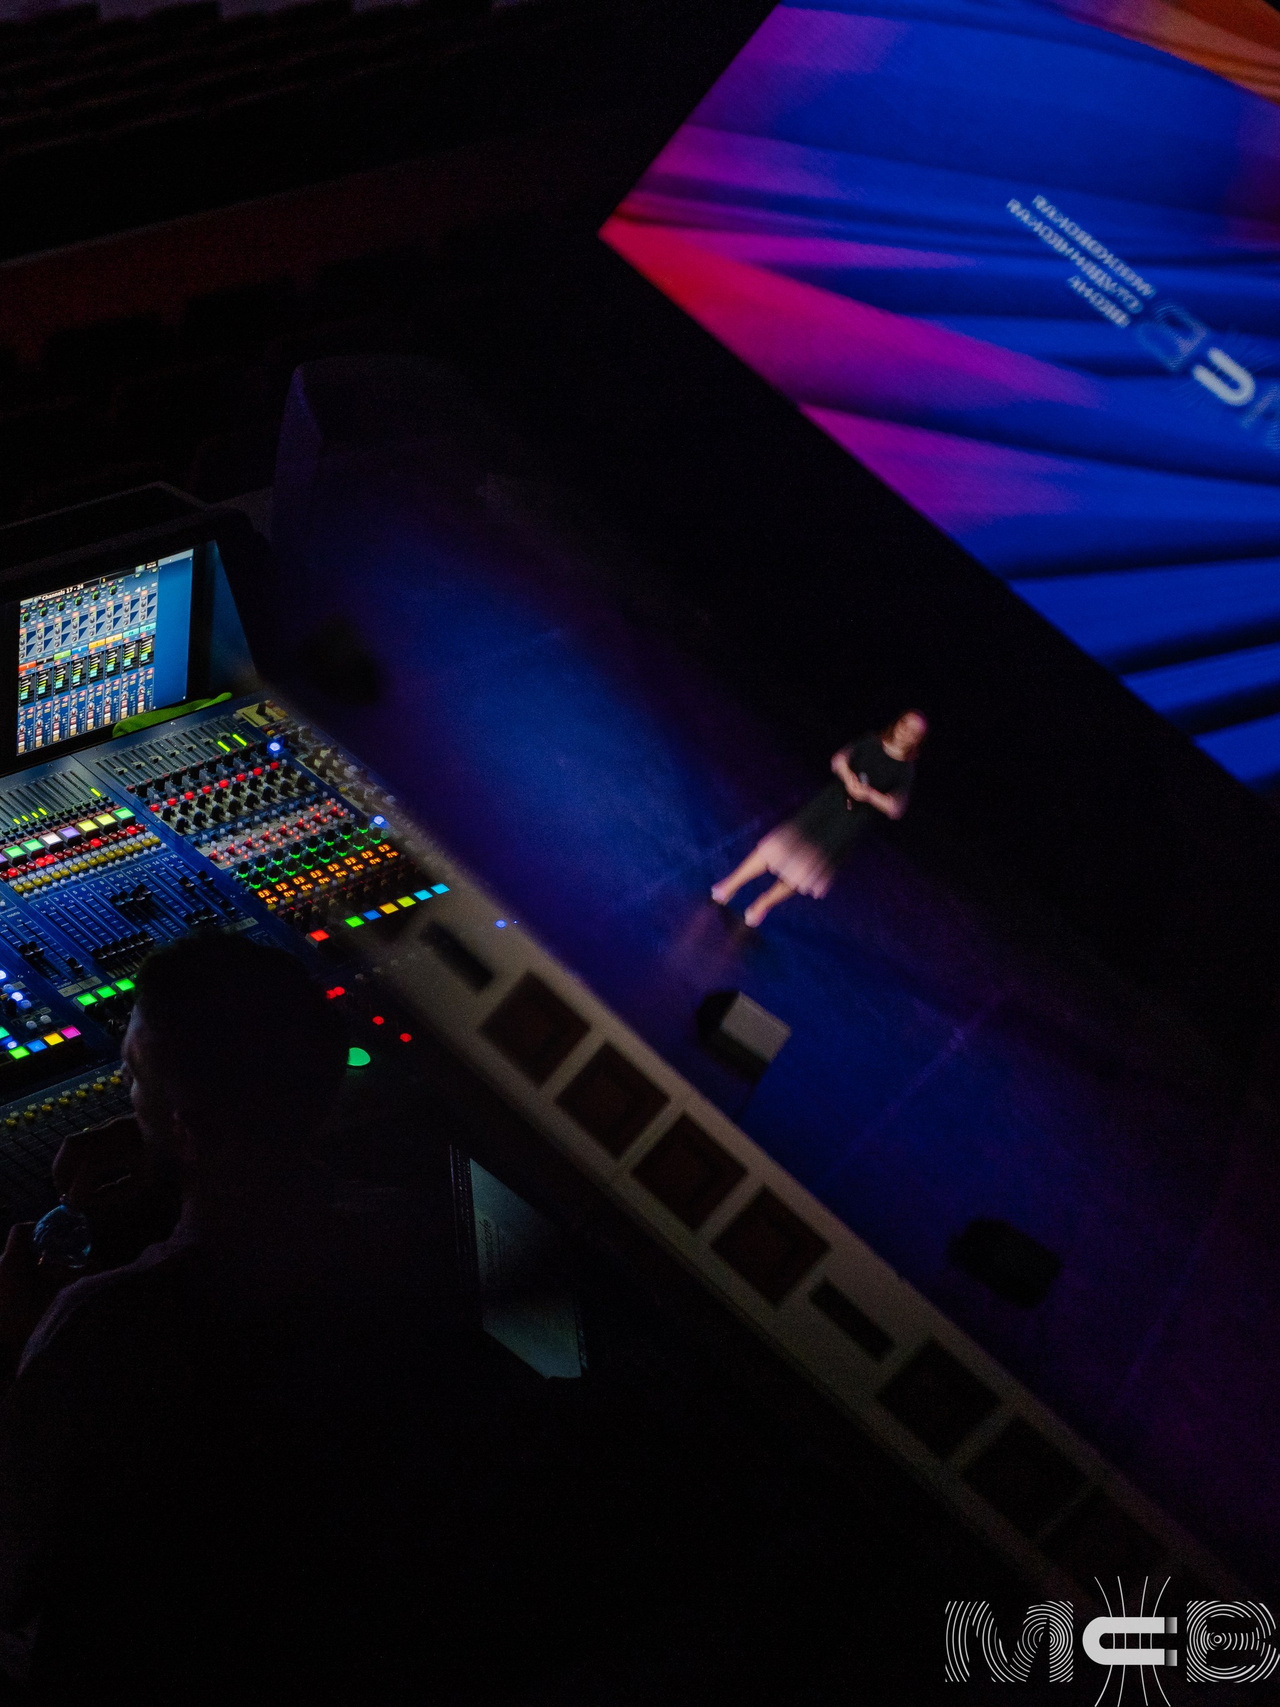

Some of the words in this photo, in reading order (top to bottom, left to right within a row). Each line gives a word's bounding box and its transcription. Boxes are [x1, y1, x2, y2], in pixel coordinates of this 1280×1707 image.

[42, 590, 65, 601] Channels
[258, 889, 271, 898] 03
[275, 882, 289, 892] 03
[293, 876, 306, 885] 03
[310, 870, 322, 879] 03
[327, 863, 340, 872] 03
[344, 857, 357, 866] 03
[361, 850, 373, 859] 03
[378, 844, 390, 853] 03
